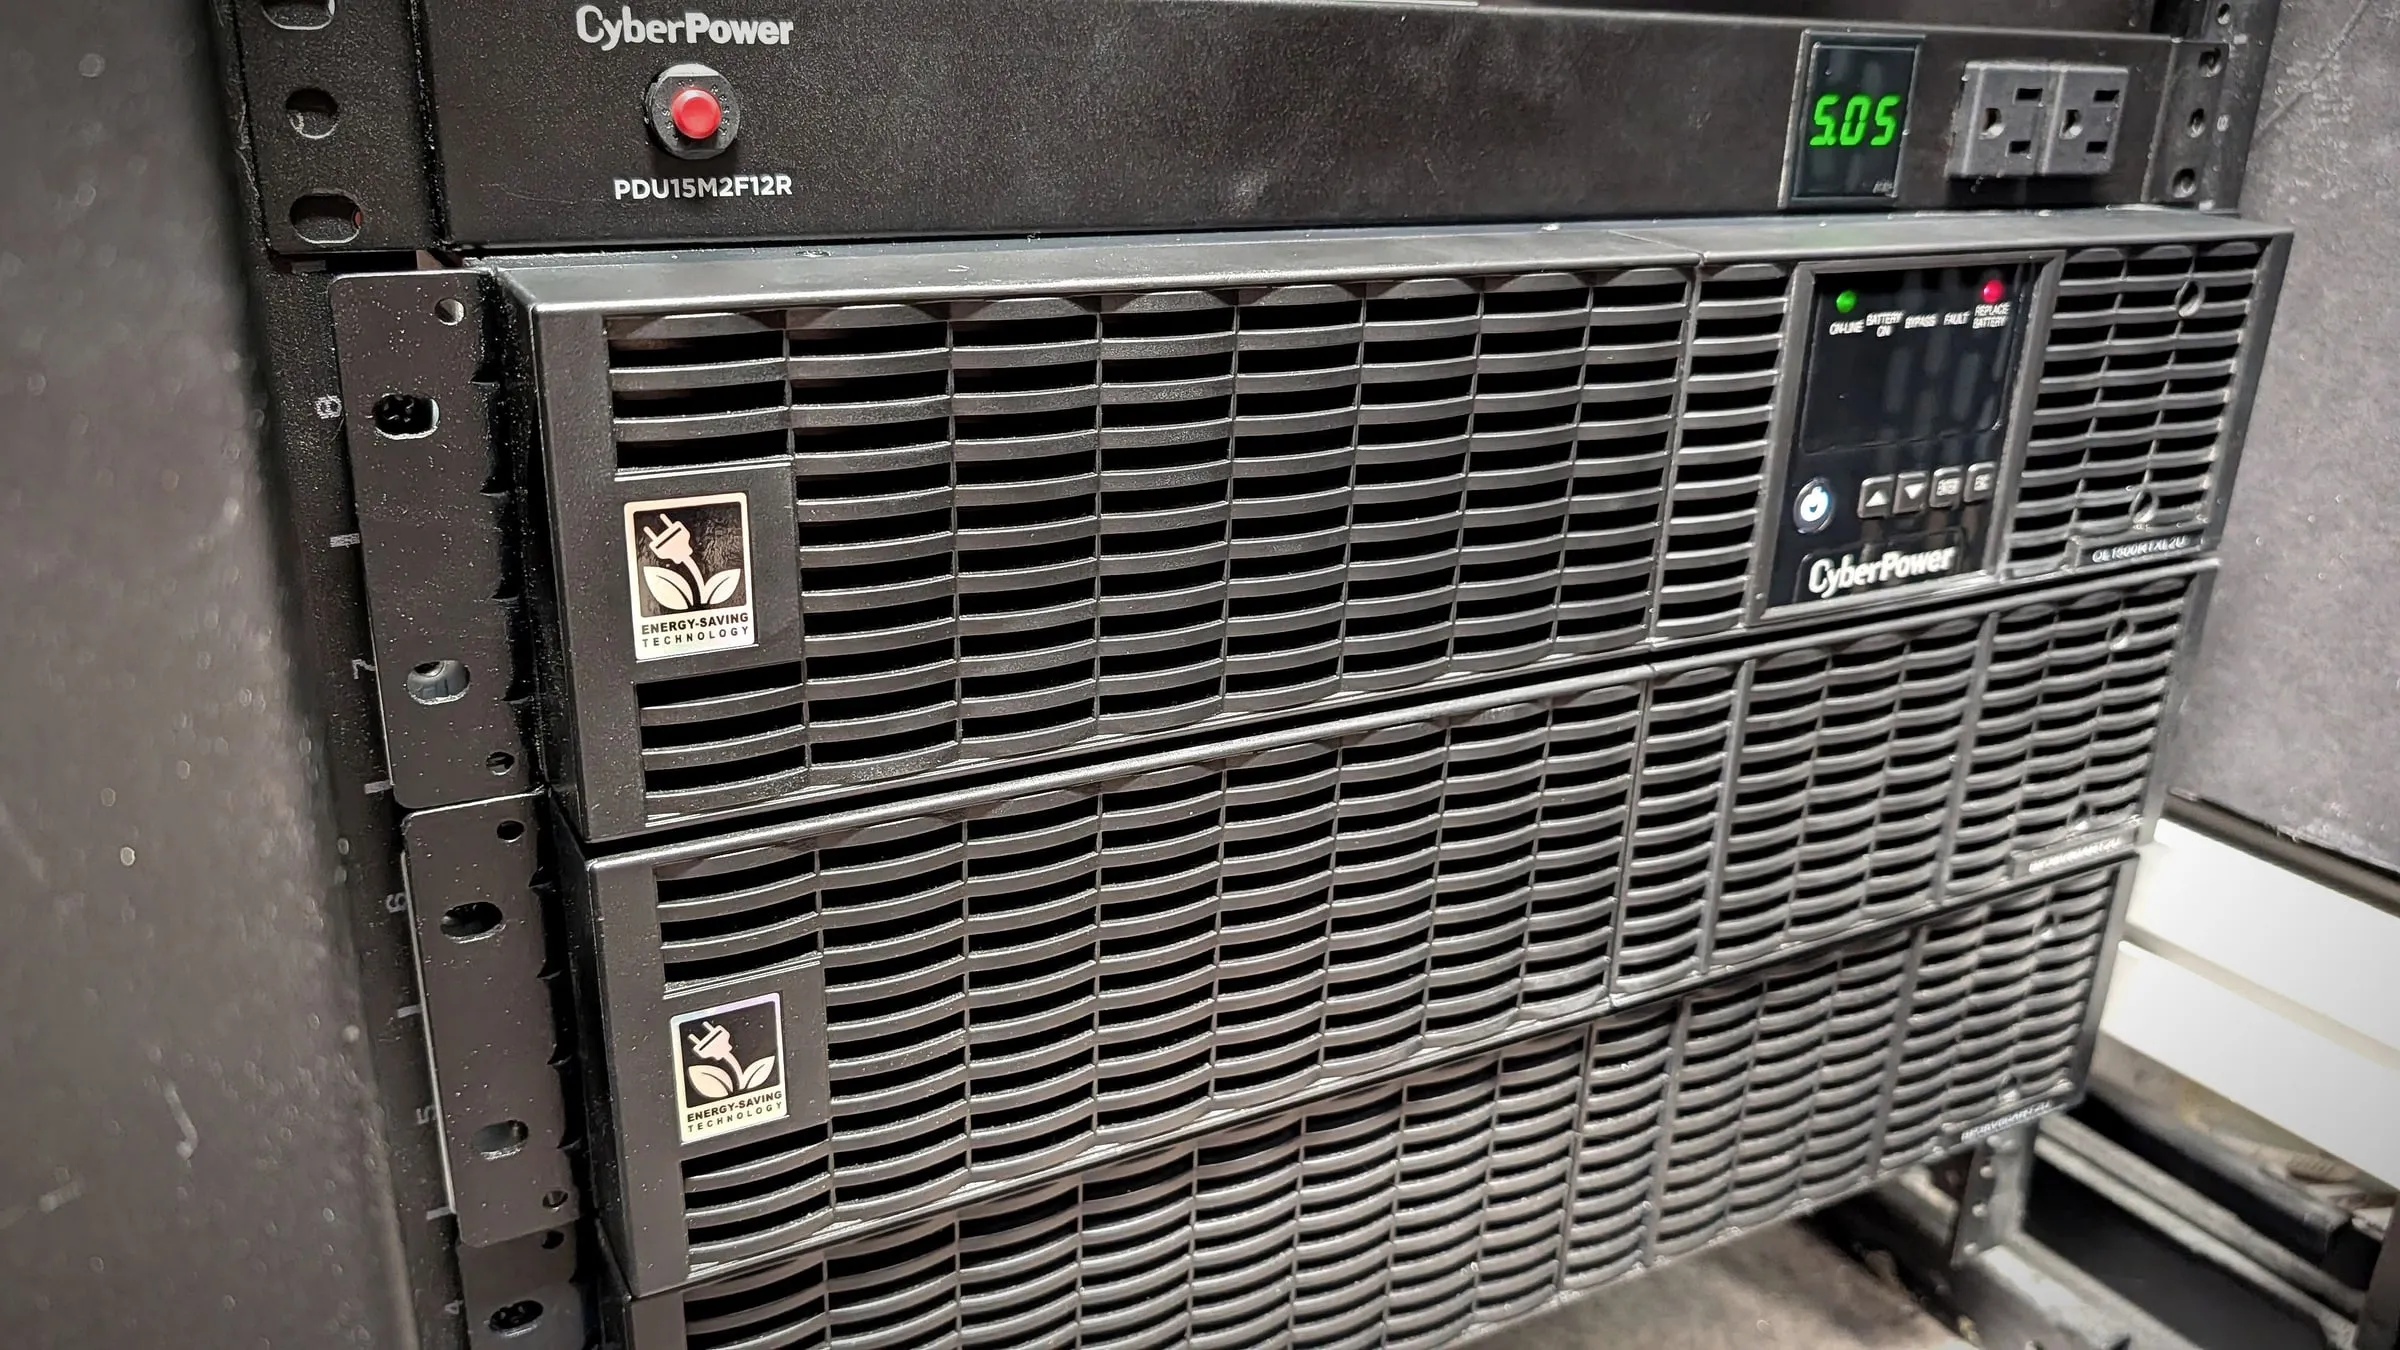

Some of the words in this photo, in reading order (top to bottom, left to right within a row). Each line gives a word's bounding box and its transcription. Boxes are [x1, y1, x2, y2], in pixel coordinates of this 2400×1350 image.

[576, 5, 794, 51] CyberPower
[614, 175, 793, 200] PDU15M2F12R
[1866, 311, 1905, 326] BATTERY
[1944, 311, 1971, 326] FAULT
[1974, 302, 2012, 317] REPLACE
[1829, 320, 1865, 335] ON-LINE
[1904, 314, 1939, 329] BYPASS
[1972, 315, 2008, 329] BATTERY
[1877, 325, 1894, 338] ON
[1808, 547, 1956, 599] CyberPower
[641, 612, 749, 635] ENERGY-SAVING
[642, 626, 749, 648] TECHNOLOGY
[687, 1090, 782, 1123] ENERGY-SAVING
[688, 1101, 782, 1133] TECHNOLOGY
